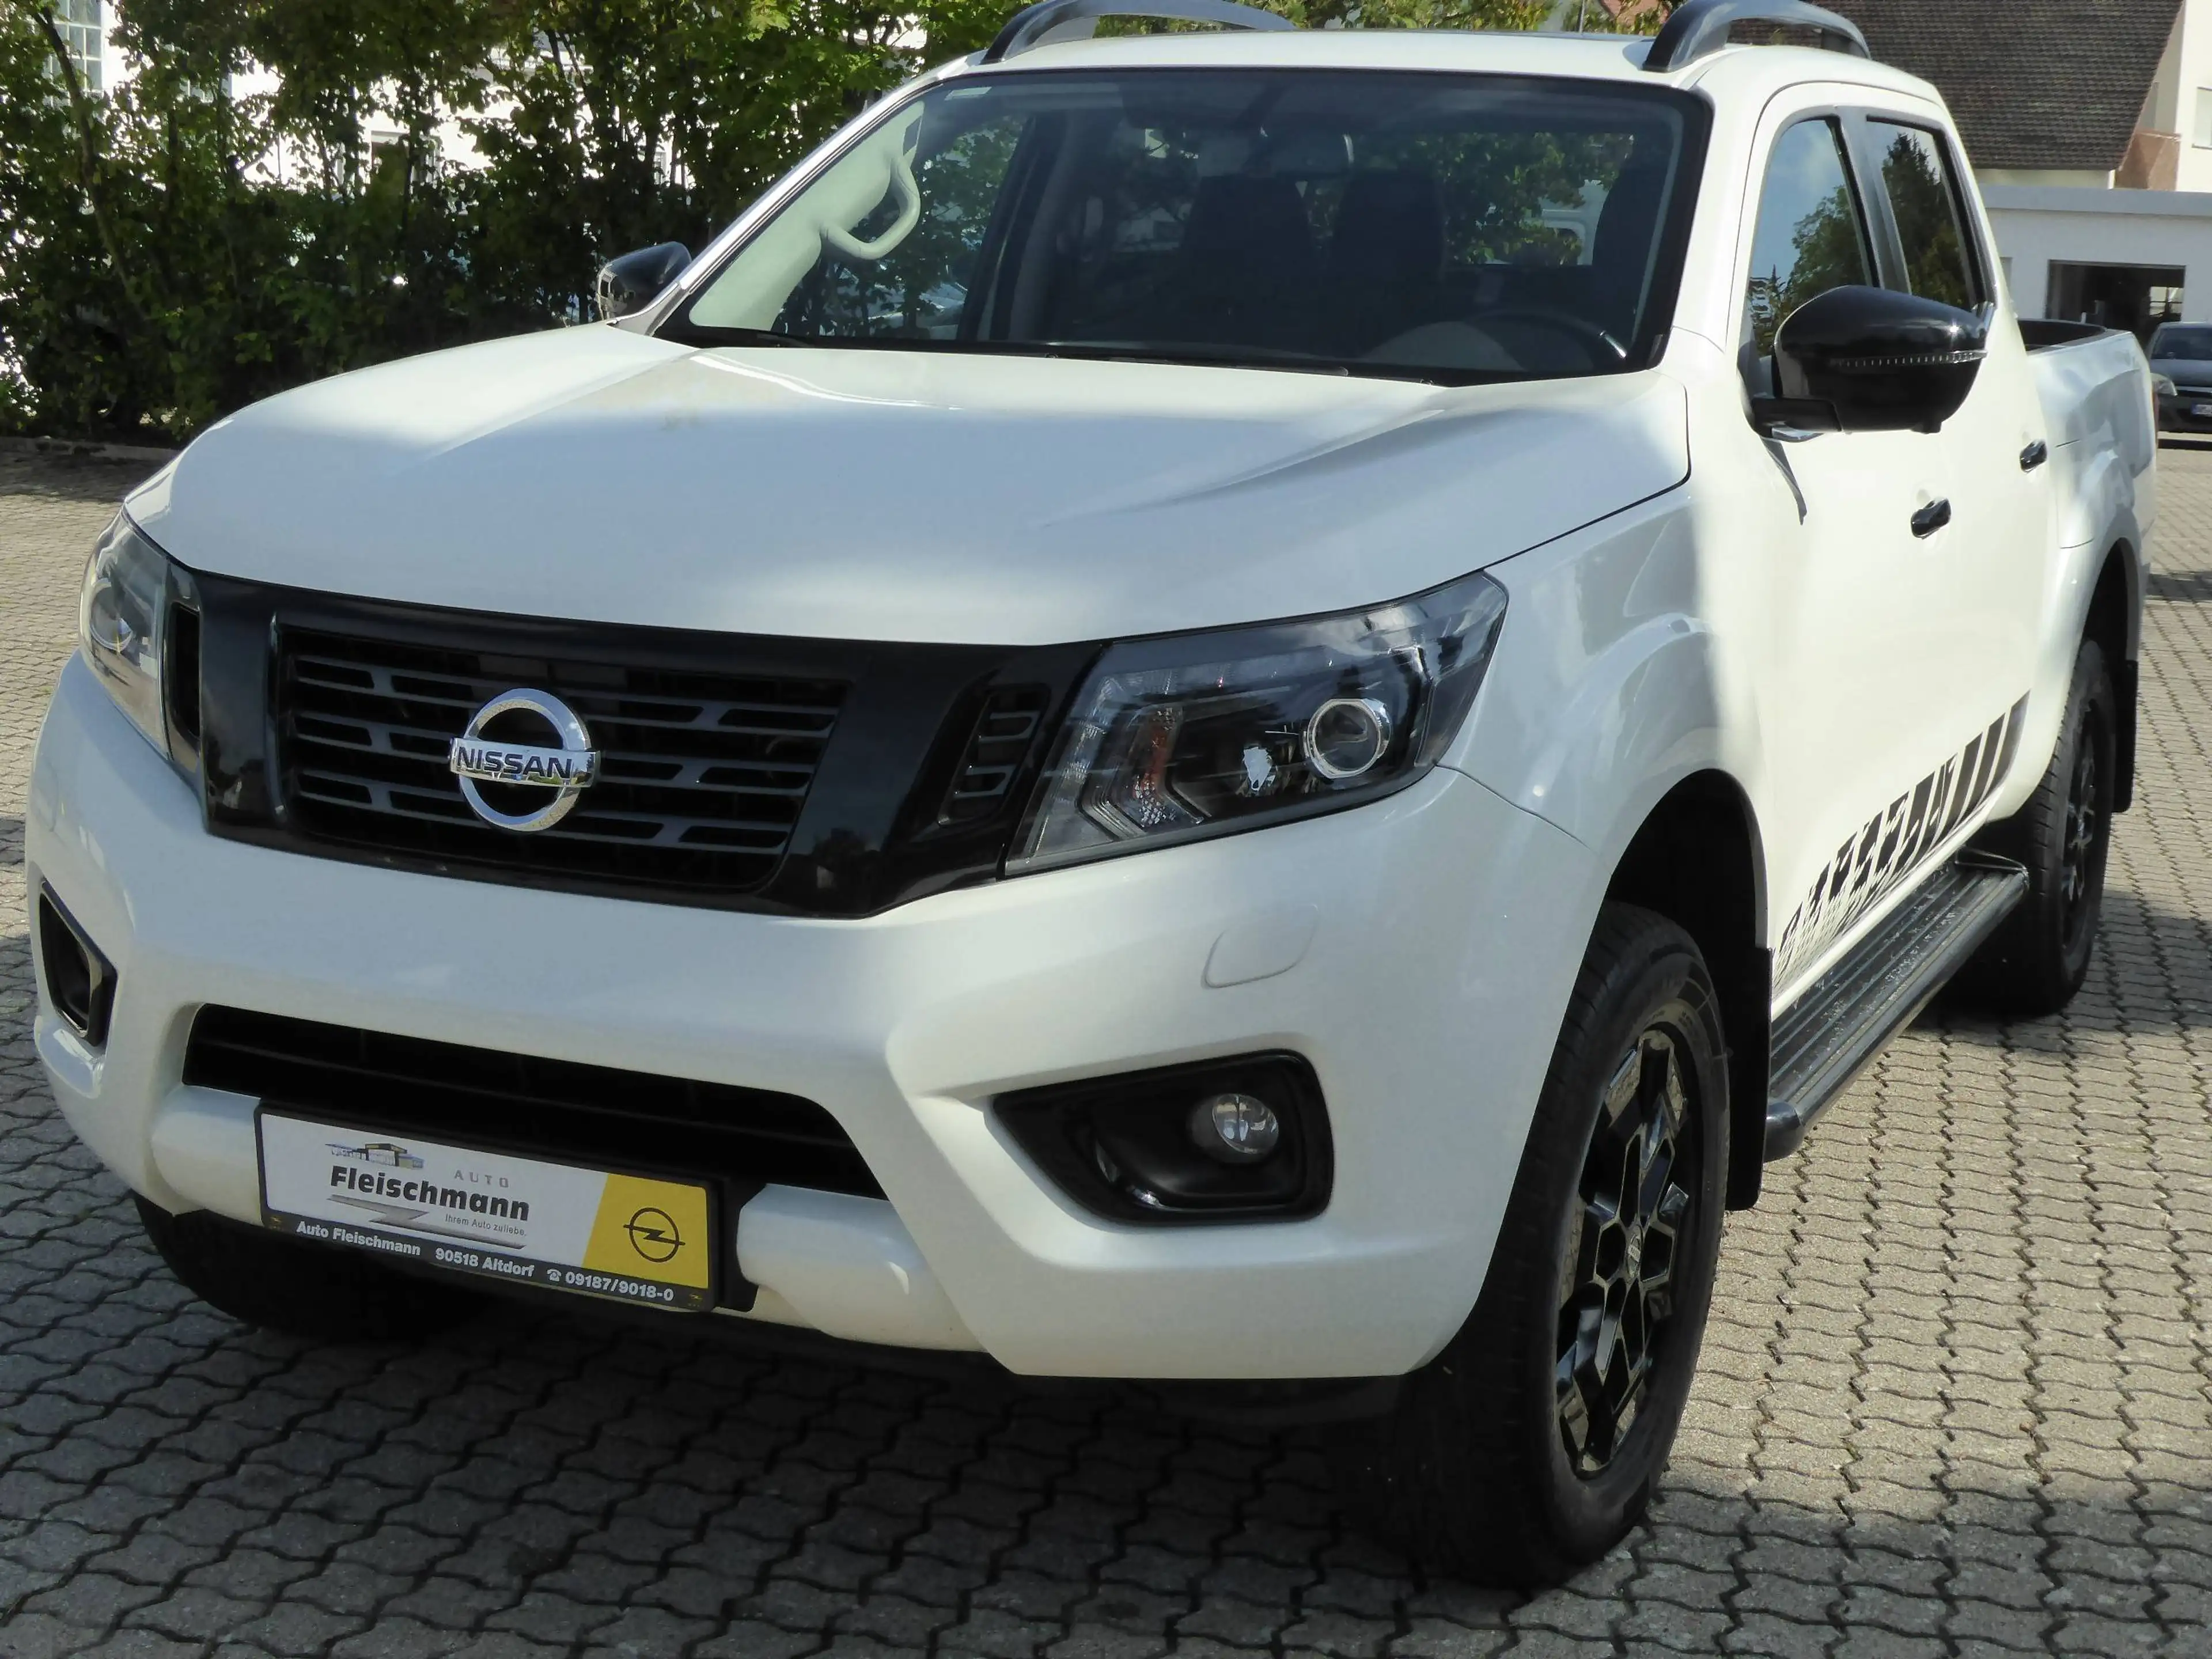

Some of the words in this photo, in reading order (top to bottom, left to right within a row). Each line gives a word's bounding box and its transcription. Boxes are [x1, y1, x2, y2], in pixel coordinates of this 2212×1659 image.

[457, 747, 572, 779] NISSAN
[330, 1165, 530, 1221] Fleischmann
[454, 1169, 509, 1188] AUTO
[445, 1213, 469, 1226] Ihrem
[471, 1218, 491, 1230] Auto
[296, 1221, 329, 1238] Auto
[332, 1228, 421, 1256] Fleischmann
[435, 1248, 479, 1268] 90518
[482, 1256, 535, 1277] Altdorf
[565, 1271, 675, 1302] 09187/9018-0
